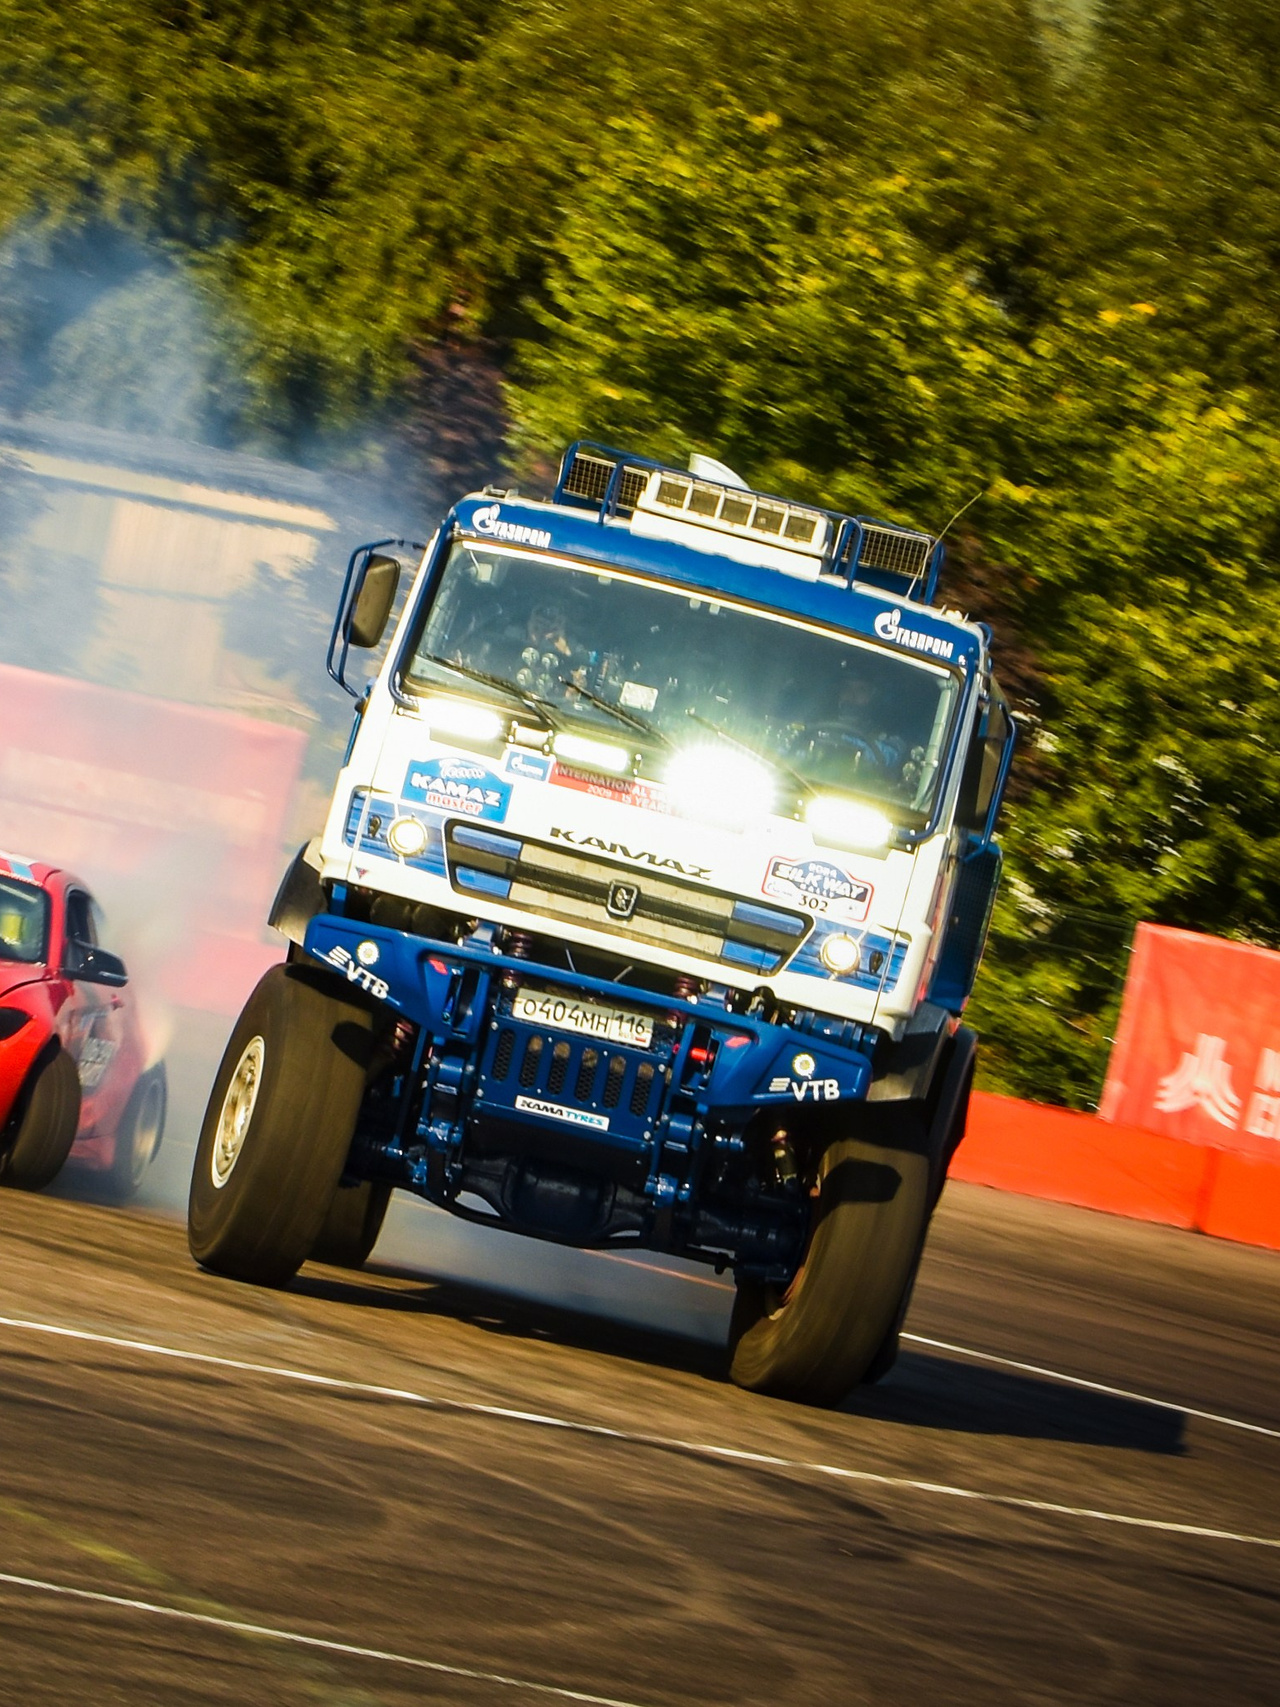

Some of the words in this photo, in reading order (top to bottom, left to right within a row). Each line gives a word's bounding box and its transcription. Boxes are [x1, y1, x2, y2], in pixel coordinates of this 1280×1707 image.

[411, 772, 501, 807] KAMAZ
[555, 765, 647, 797] INTERNATIONAL
[428, 793, 482, 814] master
[550, 827, 713, 880] KAMAZ
[775, 863, 821, 888] SILK
[823, 876, 865, 899] WAY
[798, 894, 829, 913] 302
[347, 960, 389, 999] VTB
[615, 1013, 646, 1035] 116
[791, 1079, 840, 1101] VTB
